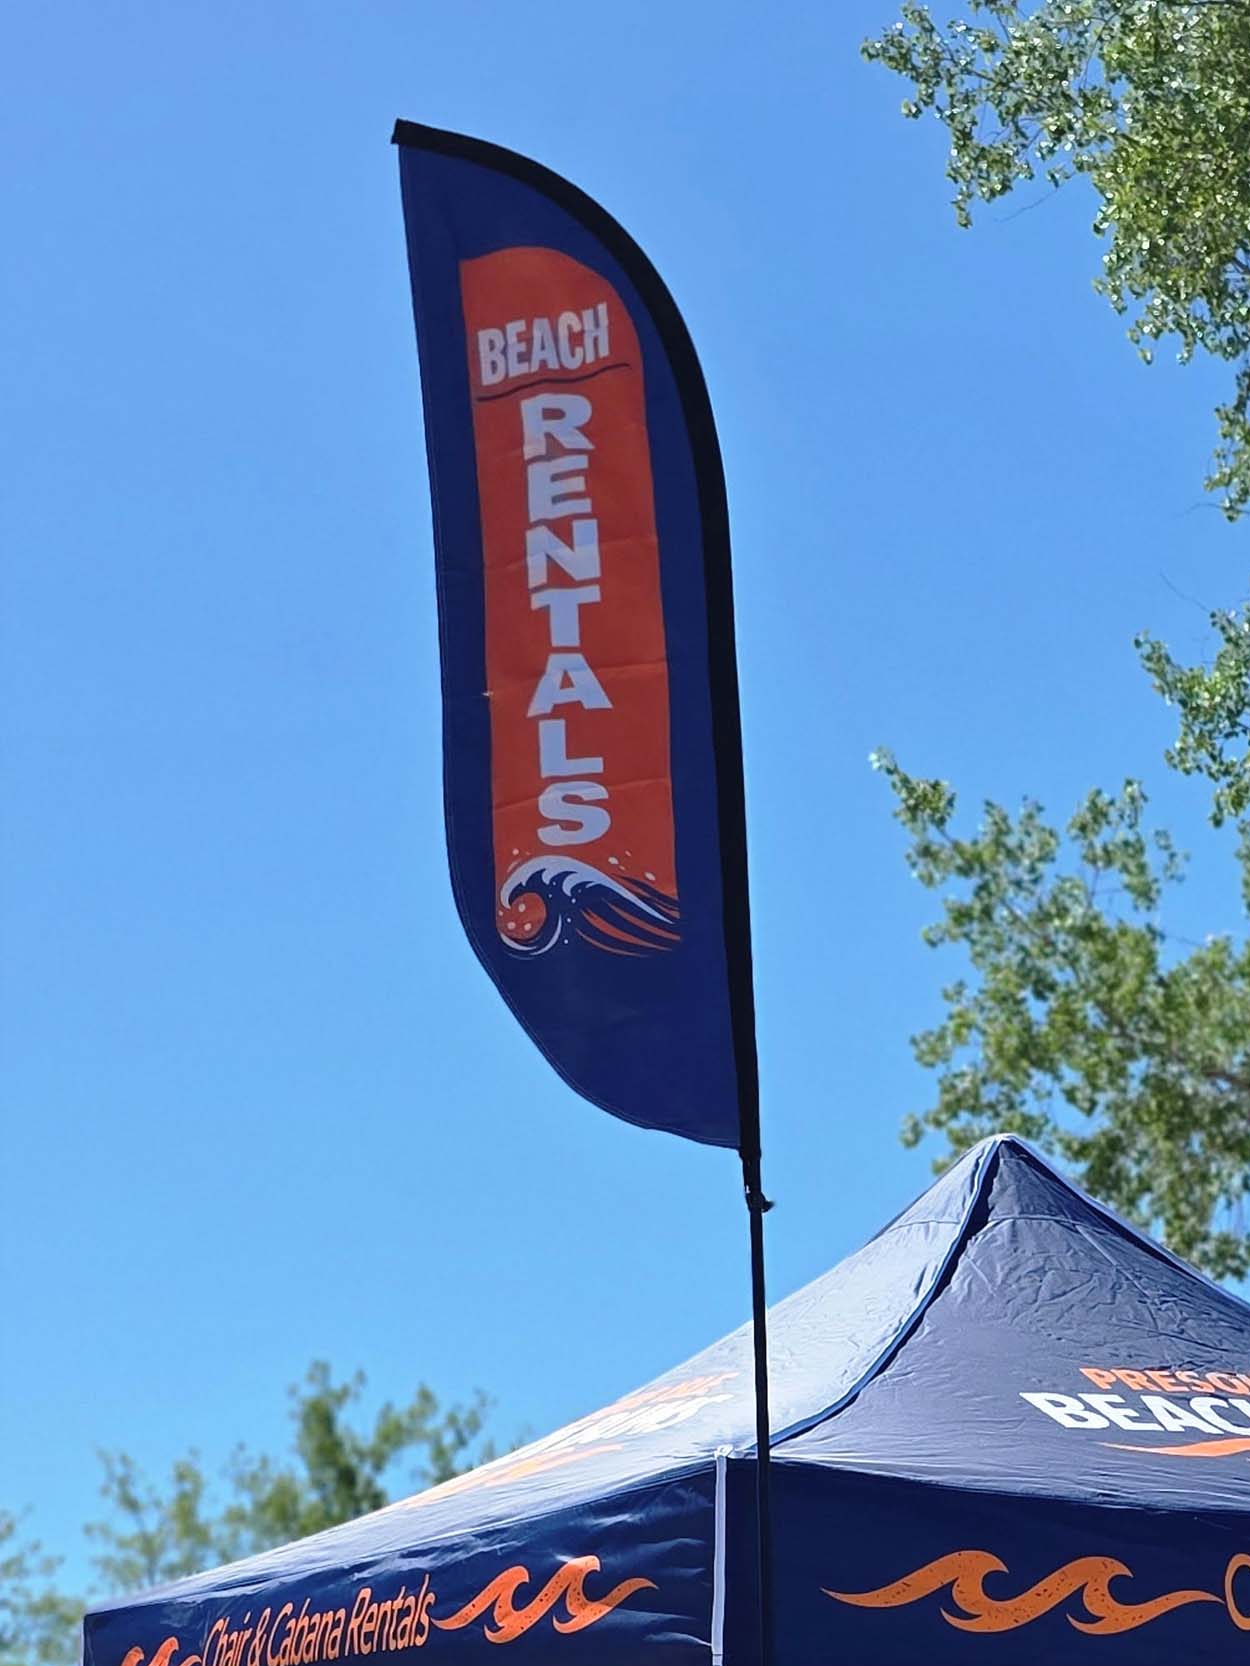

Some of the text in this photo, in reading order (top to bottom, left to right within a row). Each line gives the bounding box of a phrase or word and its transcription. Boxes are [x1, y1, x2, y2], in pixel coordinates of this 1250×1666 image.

[477, 303, 611, 386] BEACH
[521, 393, 612, 846] RENTALS
[345, 1573, 437, 1656] Rentals
